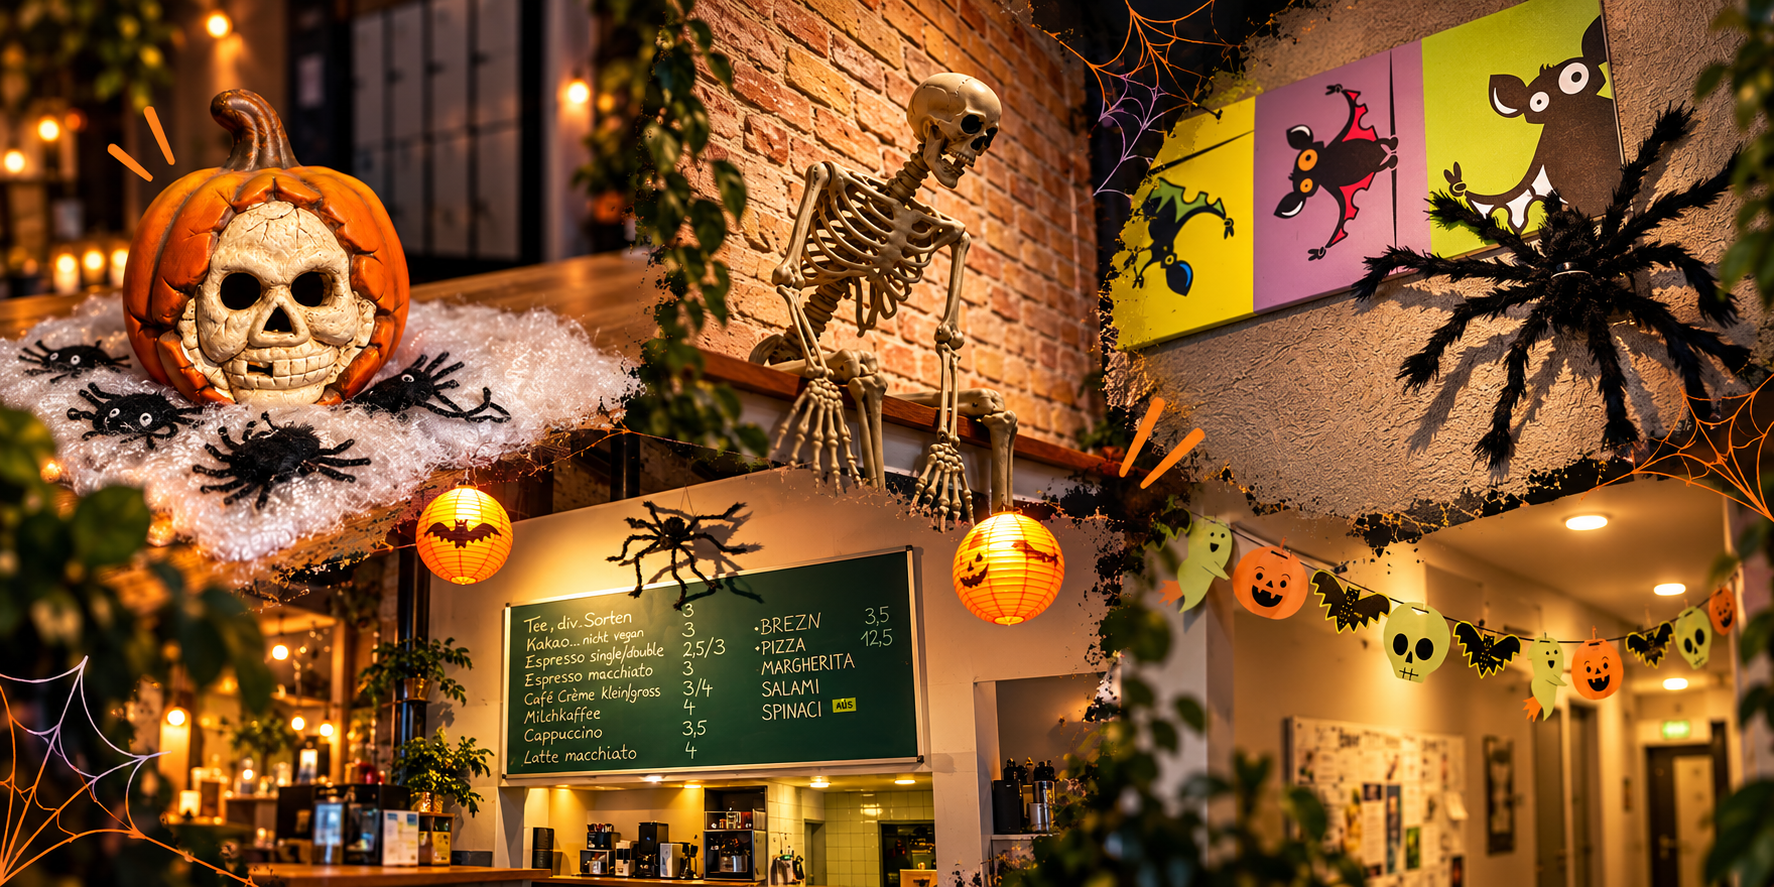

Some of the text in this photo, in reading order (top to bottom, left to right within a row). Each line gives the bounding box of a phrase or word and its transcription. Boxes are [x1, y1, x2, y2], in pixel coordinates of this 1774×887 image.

[682, 603, 694, 618] 3
[864, 606, 890, 626] 3,5
[614, 629, 644, 644] vegan
[682, 622, 696, 638] 3
[860, 628, 893, 647] 12,5
[525, 636, 726, 671] Espresso single/double 2,5/3
[761, 652, 856, 676] MARGHERITA
[525, 660, 694, 690] Espresso macchiato 3
[524, 690, 554, 707] Café
[558, 688, 596, 703] Crème
[682, 678, 714, 698] 3/4
[762, 678, 820, 698] SALAMI
[524, 699, 696, 724] Milchkaffee 4
[762, 701, 822, 720] SPINACI
[524, 720, 708, 746] Cappuccino 3,5
[524, 742, 698, 764] Latte macchiato 4
